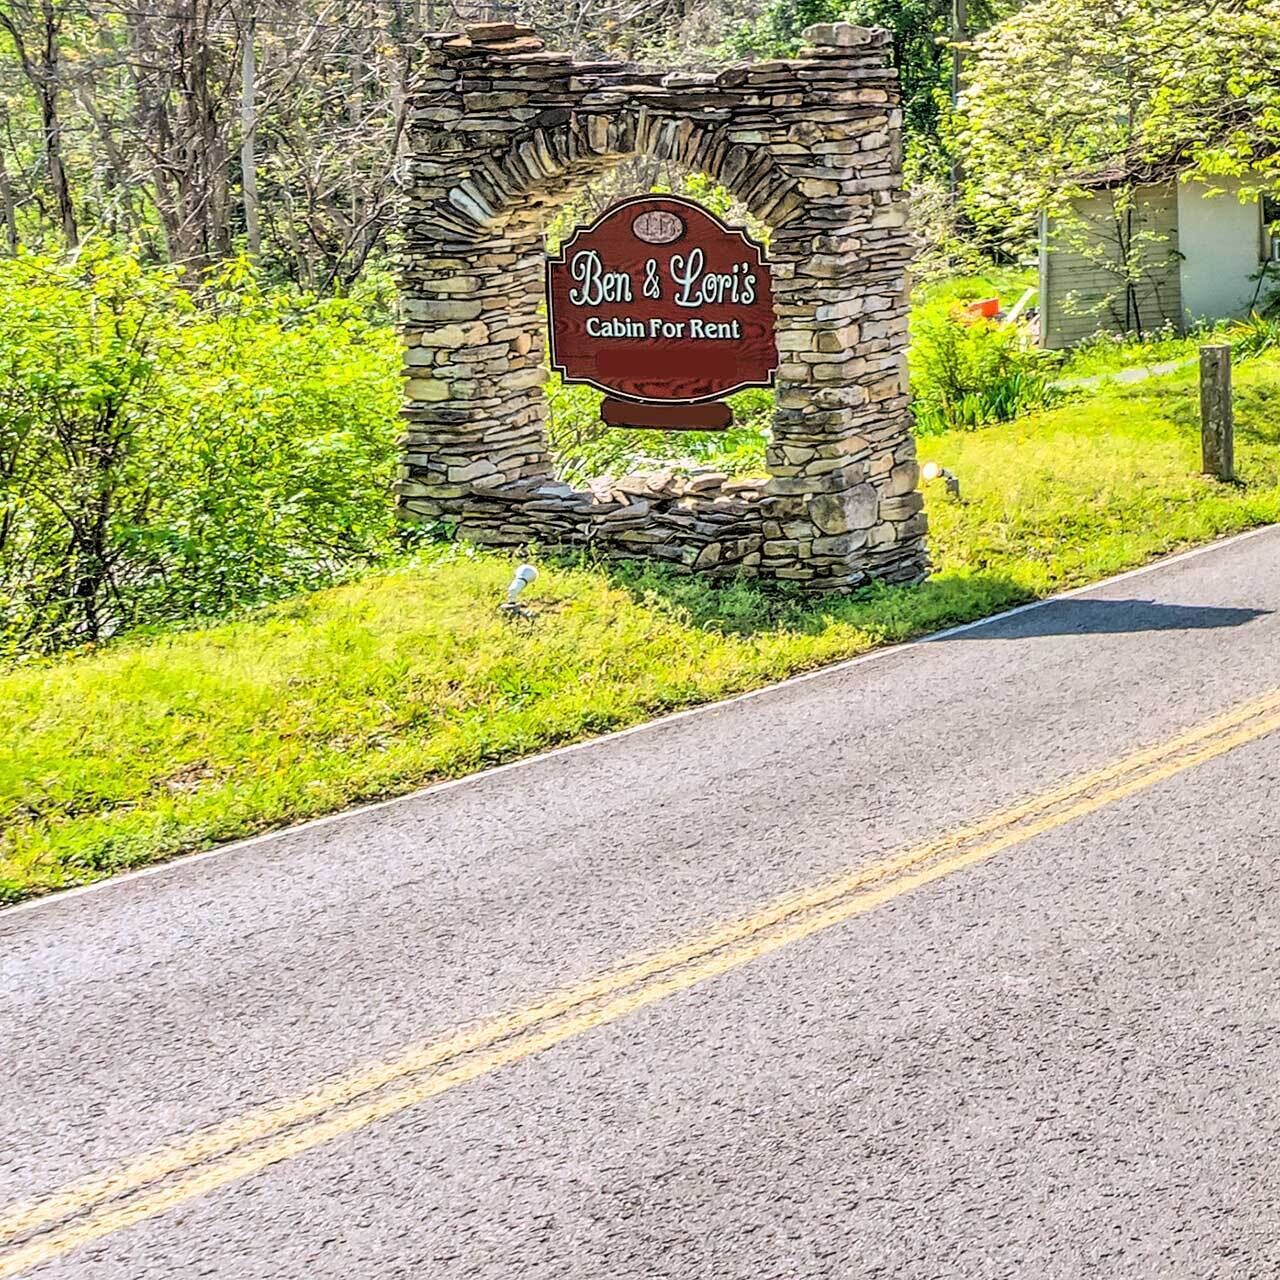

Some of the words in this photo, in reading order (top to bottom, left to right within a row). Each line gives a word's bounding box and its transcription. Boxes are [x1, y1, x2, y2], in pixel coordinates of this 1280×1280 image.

[569, 250, 632, 305] Ben
[643, 259, 660, 299] &
[670, 248, 756, 307] Lori's
[586, 317, 645, 338] Cabin
[650, 319, 685, 338] For
[690, 319, 740, 339] Rent
